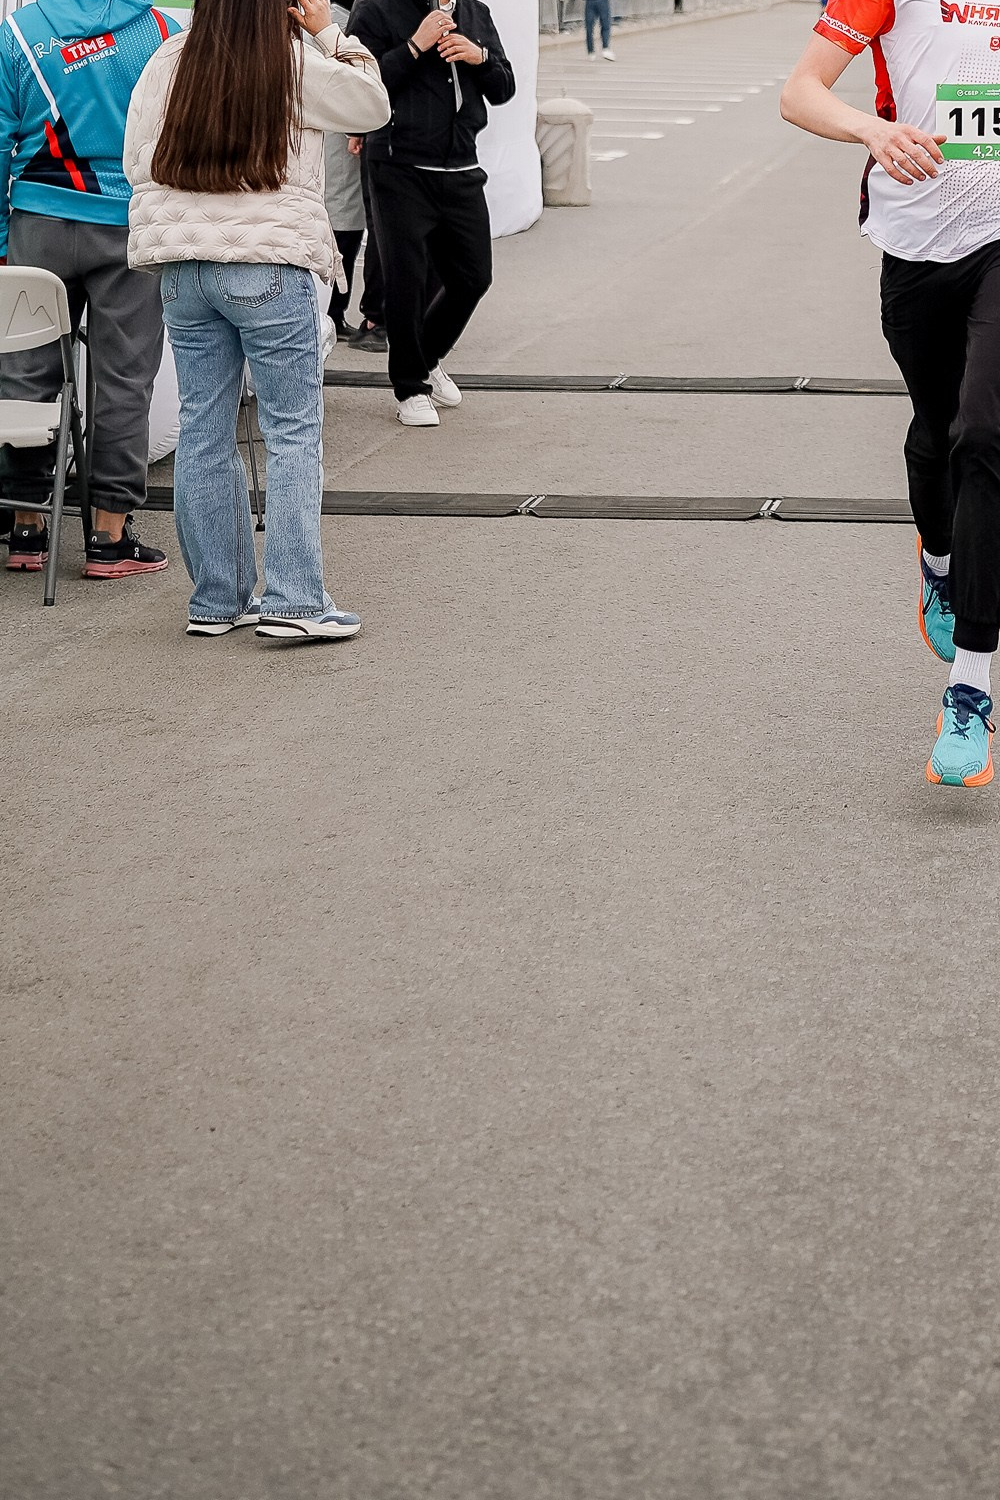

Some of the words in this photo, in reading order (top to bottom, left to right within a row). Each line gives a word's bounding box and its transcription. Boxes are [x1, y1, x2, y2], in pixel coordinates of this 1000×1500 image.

[67, 36, 107, 59] TIME
[63, 58, 88, 75] ВРЕМЯ
[972, 145, 993, 158] 4,2
